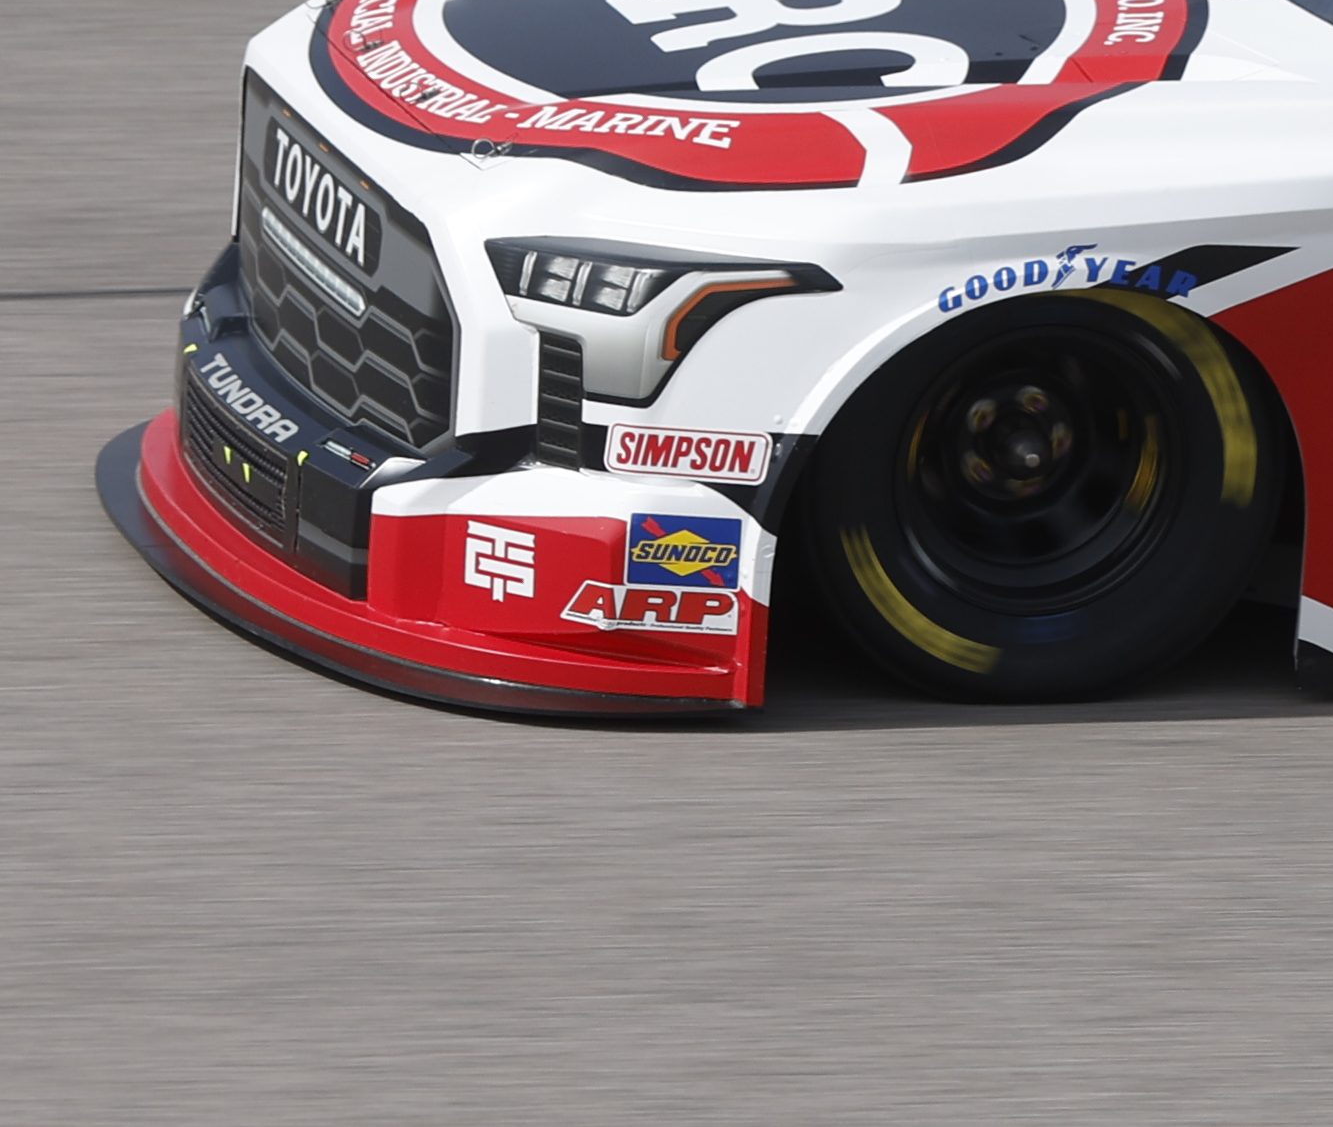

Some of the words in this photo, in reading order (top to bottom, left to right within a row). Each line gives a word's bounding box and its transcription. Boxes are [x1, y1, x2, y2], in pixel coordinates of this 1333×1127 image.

[1103, 11, 1165, 46] INC.
[516, 105, 741, 149] MARINE
[274, 127, 366, 267] TOYOTA
[200, 352, 300, 443] TUNDRA
[616, 431, 756, 473] SIMPSON
[636, 543, 735, 564] SUNOCO
[568, 583, 735, 625] ARP
